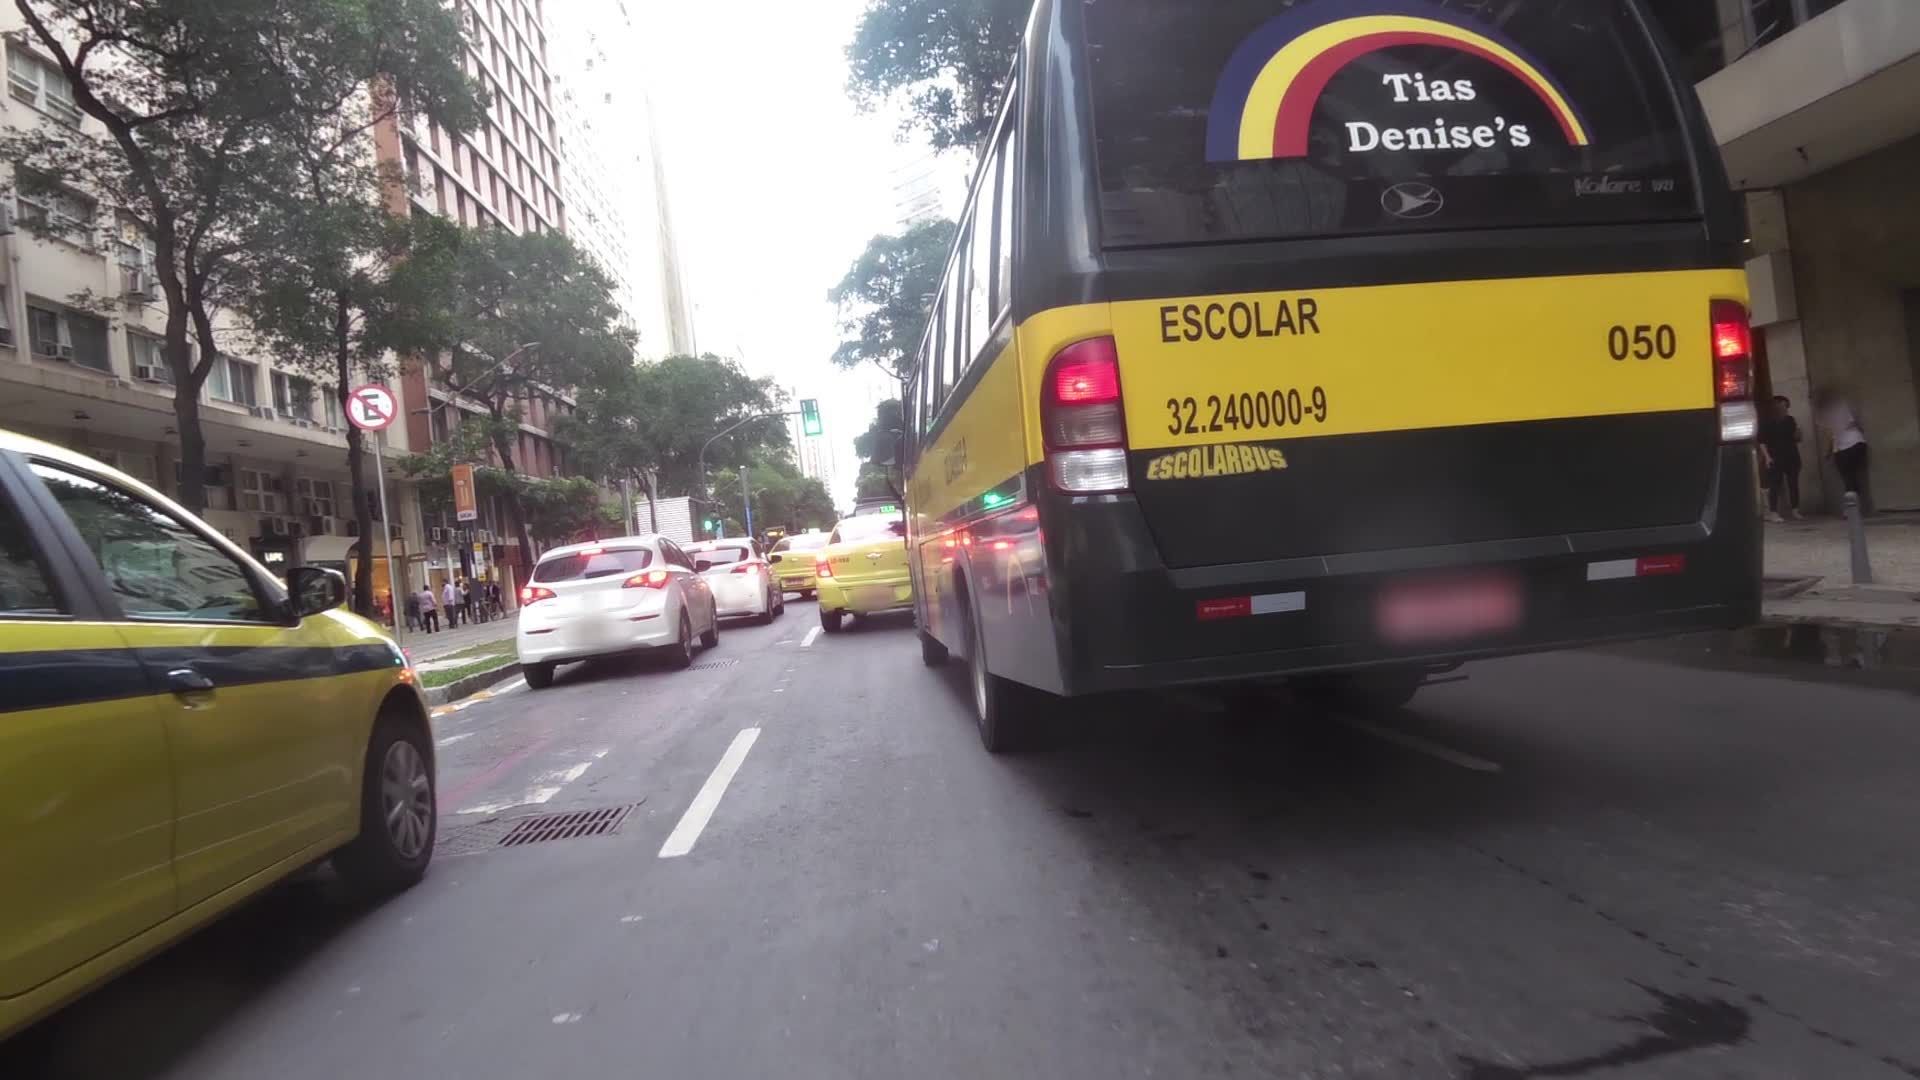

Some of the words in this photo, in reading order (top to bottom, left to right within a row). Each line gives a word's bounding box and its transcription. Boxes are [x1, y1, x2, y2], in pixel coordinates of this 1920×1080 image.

[1382, 72, 1476, 102] Tias
[1345, 116, 1531, 152] Denise's
[1160, 297, 1320, 343] ESCOLAR
[1608, 323, 1676, 361] 050
[1166, 385, 1327, 436] 32.240000-9
[1147, 444, 1288, 480] ESCOLARBUS
